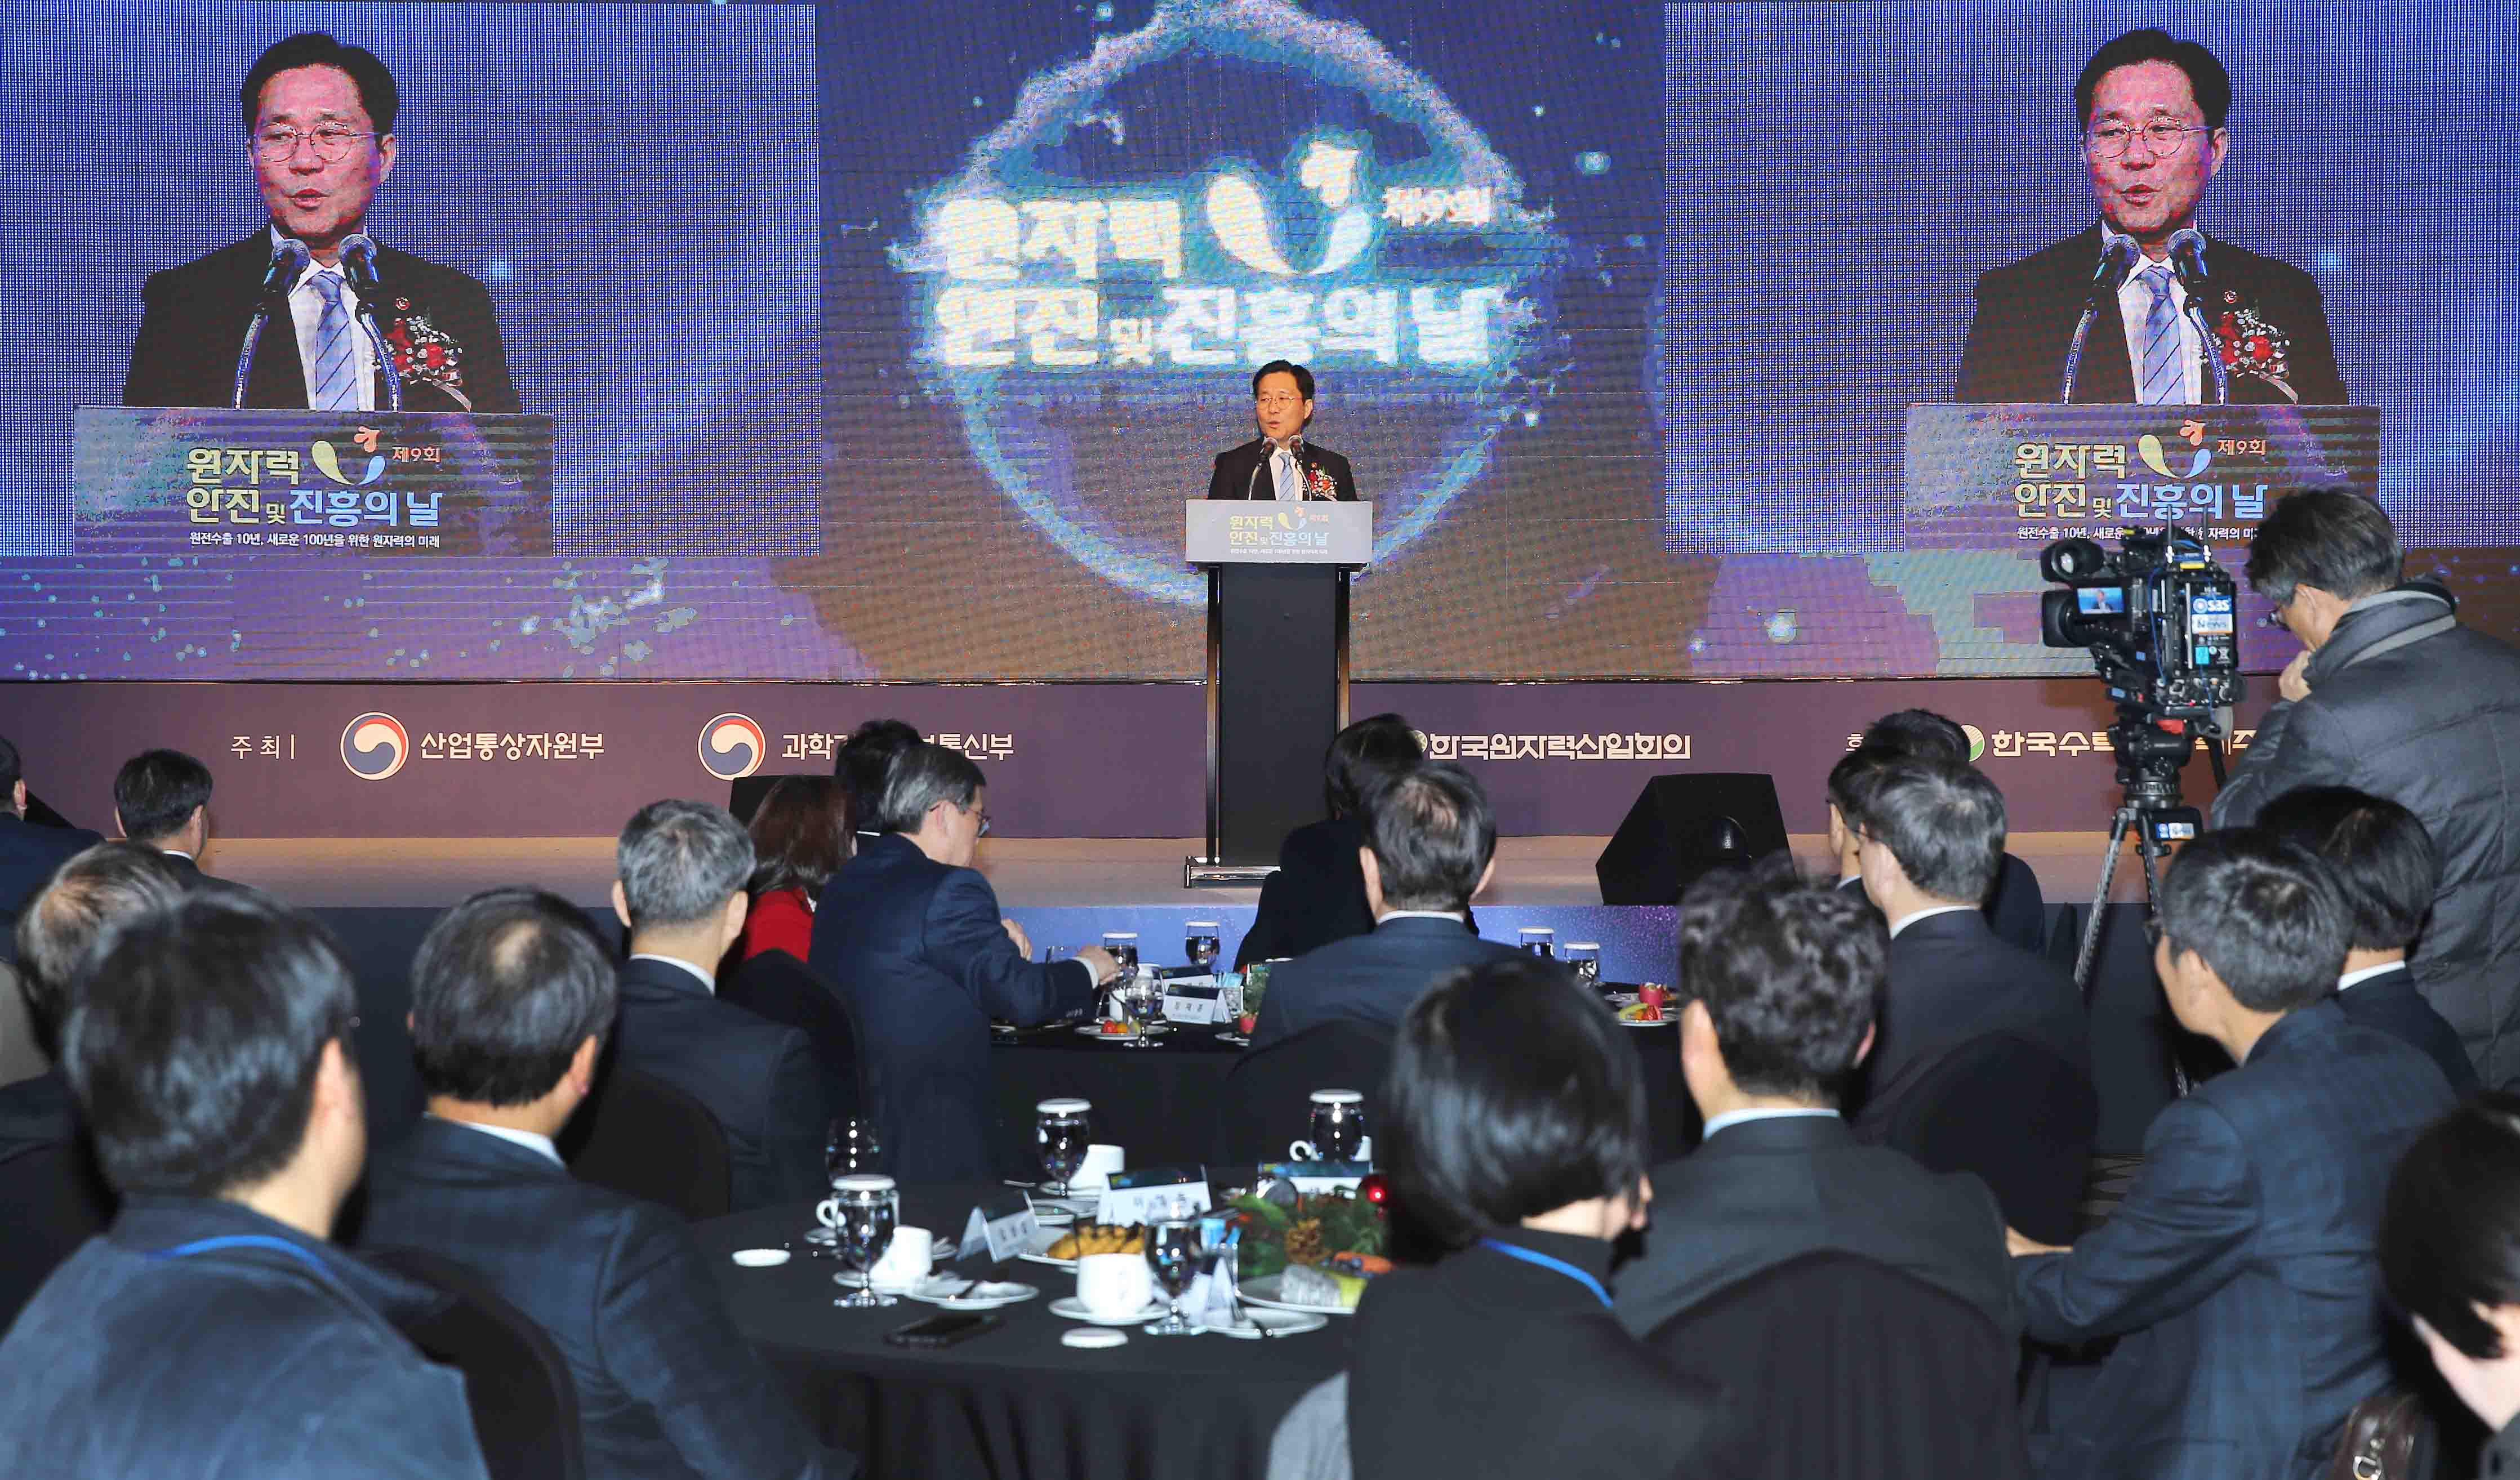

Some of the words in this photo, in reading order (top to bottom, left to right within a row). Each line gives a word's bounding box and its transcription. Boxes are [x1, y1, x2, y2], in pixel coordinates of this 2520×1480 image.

[1108, 318, 1154, 366] 및
[1161, 286, 1398, 366] 진흥의
[1410, 285, 1504, 364] 날
[391, 447, 441, 463] 제9회
[2218, 439, 2267, 456] 제9회
[186, 448, 300, 485] 원자력
[2015, 443, 2126, 479] 원자력
[266, 502, 286, 524] 및
[290, 489, 397, 527] 진흥의
[406, 491, 444, 527] 날
[2092, 497, 2113, 519] 및
[2116, 483, 2223, 520] 진흥의
[2232, 484, 2268, 519] 날
[1230, 515, 1274, 531] 원자력
[2017, 526, 2060, 540] 원전수출
[2063, 527, 2091, 540] 10년,
[189, 531, 233, 545] 원전수출
[237, 532, 264, 546] 10년,
[267, 532, 300, 546] 새로운
[303, 533, 345, 547] 100년을
[348, 534, 370, 547] 위한
[372, 534, 415, 547] 원자력의
[418, 534, 440, 549] 미래
[1315, 532, 1330, 546] 날
[420, 732, 605, 761] 산업통상자원부
[1428, 732, 1690, 760] 한국원자력산업회의
